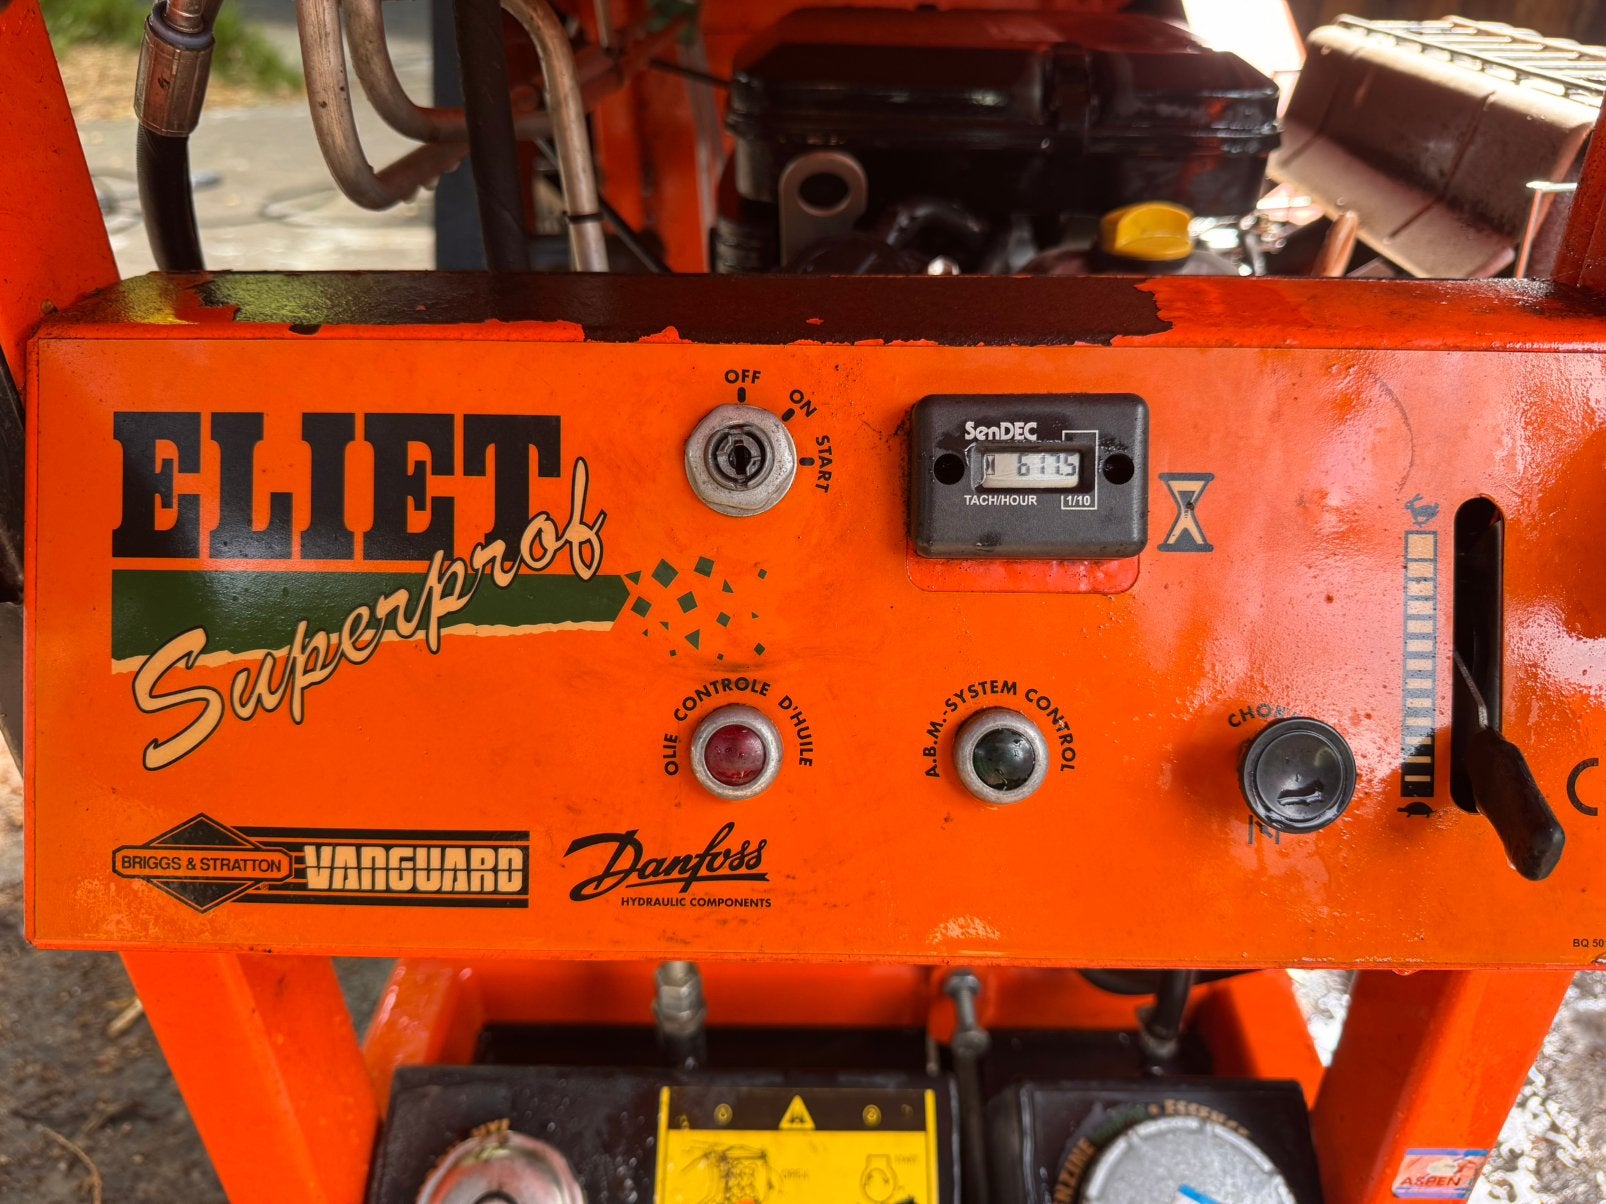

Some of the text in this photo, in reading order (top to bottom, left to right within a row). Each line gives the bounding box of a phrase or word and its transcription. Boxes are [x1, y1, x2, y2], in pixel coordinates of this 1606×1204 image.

[724, 369, 761, 384] OFF
[789, 389, 818, 418] ON
[964, 421, 1038, 440] SenDEC
[815, 435, 833, 493] START
[111, 411, 562, 560] ELIET
[963, 495, 1038, 506] TACH/HOUR
[1066, 495, 1091, 506] 1/10
[132, 456, 607, 771] Superprof
[663, 677, 813, 776] OLIE CONTROLE D'HUILE
[923, 680, 1076, 778] A.B.M.-SYSTEM CONTROL
[121, 855, 282, 872] BRIGGS & STRATTON
[304, 845, 523, 892] VANGUARD
[563, 821, 768, 902] Danfoss
[621, 897, 771, 908] HYDRAULIC COMPONENTS
[1573, 938, 1606, 947] BQ 50
[1400, 1176, 1463, 1187] ASPEN
